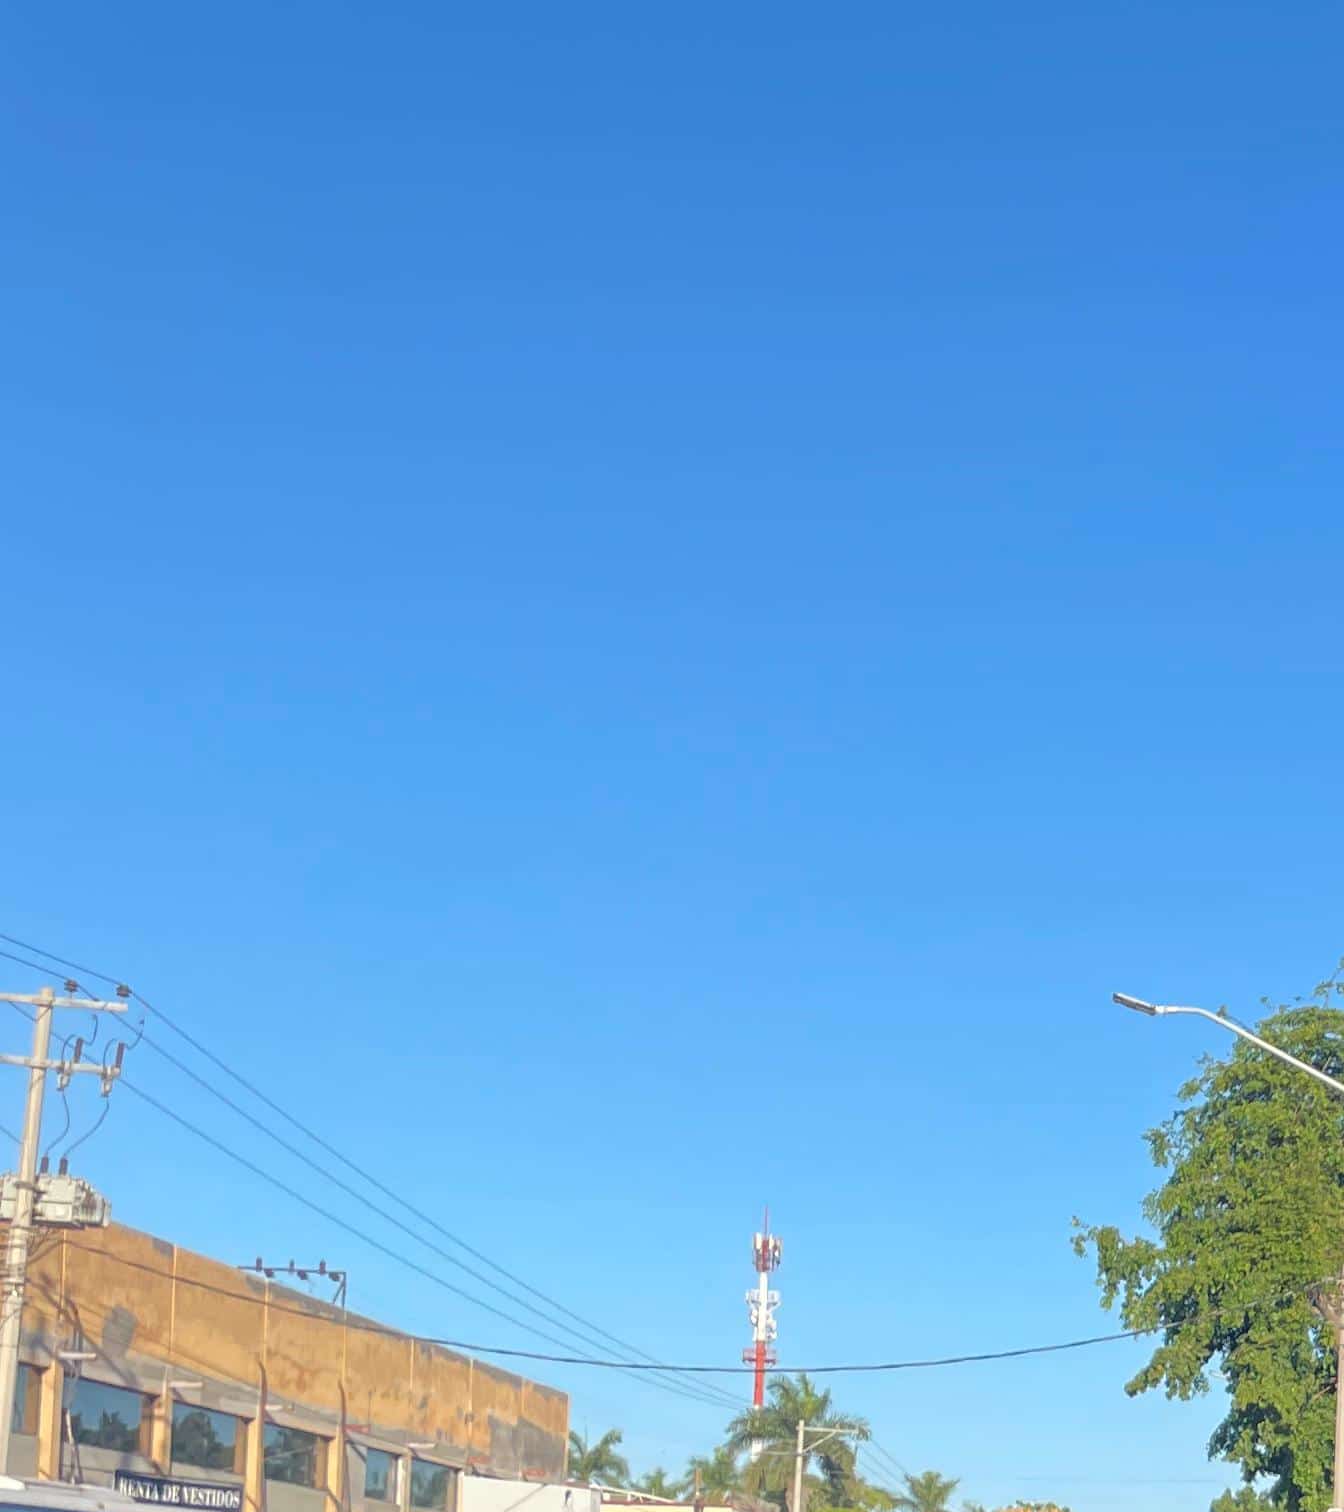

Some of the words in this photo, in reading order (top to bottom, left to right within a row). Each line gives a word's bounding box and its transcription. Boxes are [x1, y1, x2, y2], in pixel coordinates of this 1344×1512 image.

[120, 1478, 159, 1500] RENTA
[162, 1484, 180, 1503] DE
[182, 1485, 240, 1508] VESTIDOS
